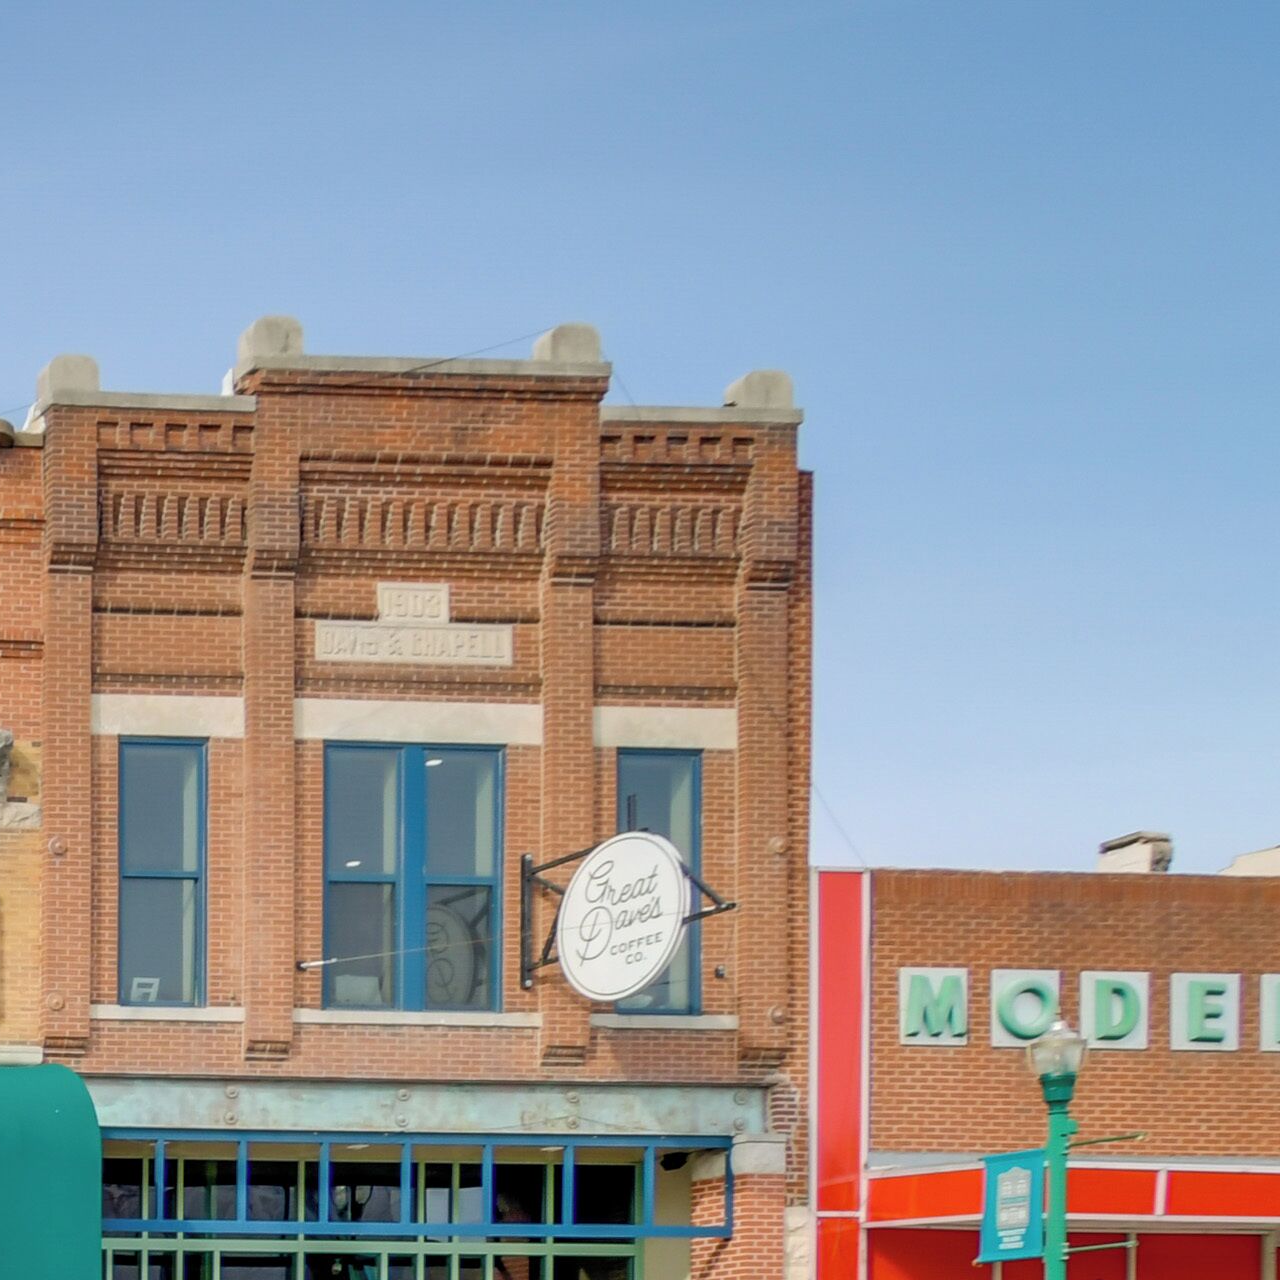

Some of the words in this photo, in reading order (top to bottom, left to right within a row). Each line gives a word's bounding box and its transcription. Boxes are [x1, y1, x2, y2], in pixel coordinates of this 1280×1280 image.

[381, 592, 441, 618] 1903
[584, 860, 659, 906] Great
[576, 896, 664, 968] Dave's
[609, 931, 664, 956] COFFEE
[624, 951, 648, 965] CO.
[904, 974, 1280, 1043] MODE
